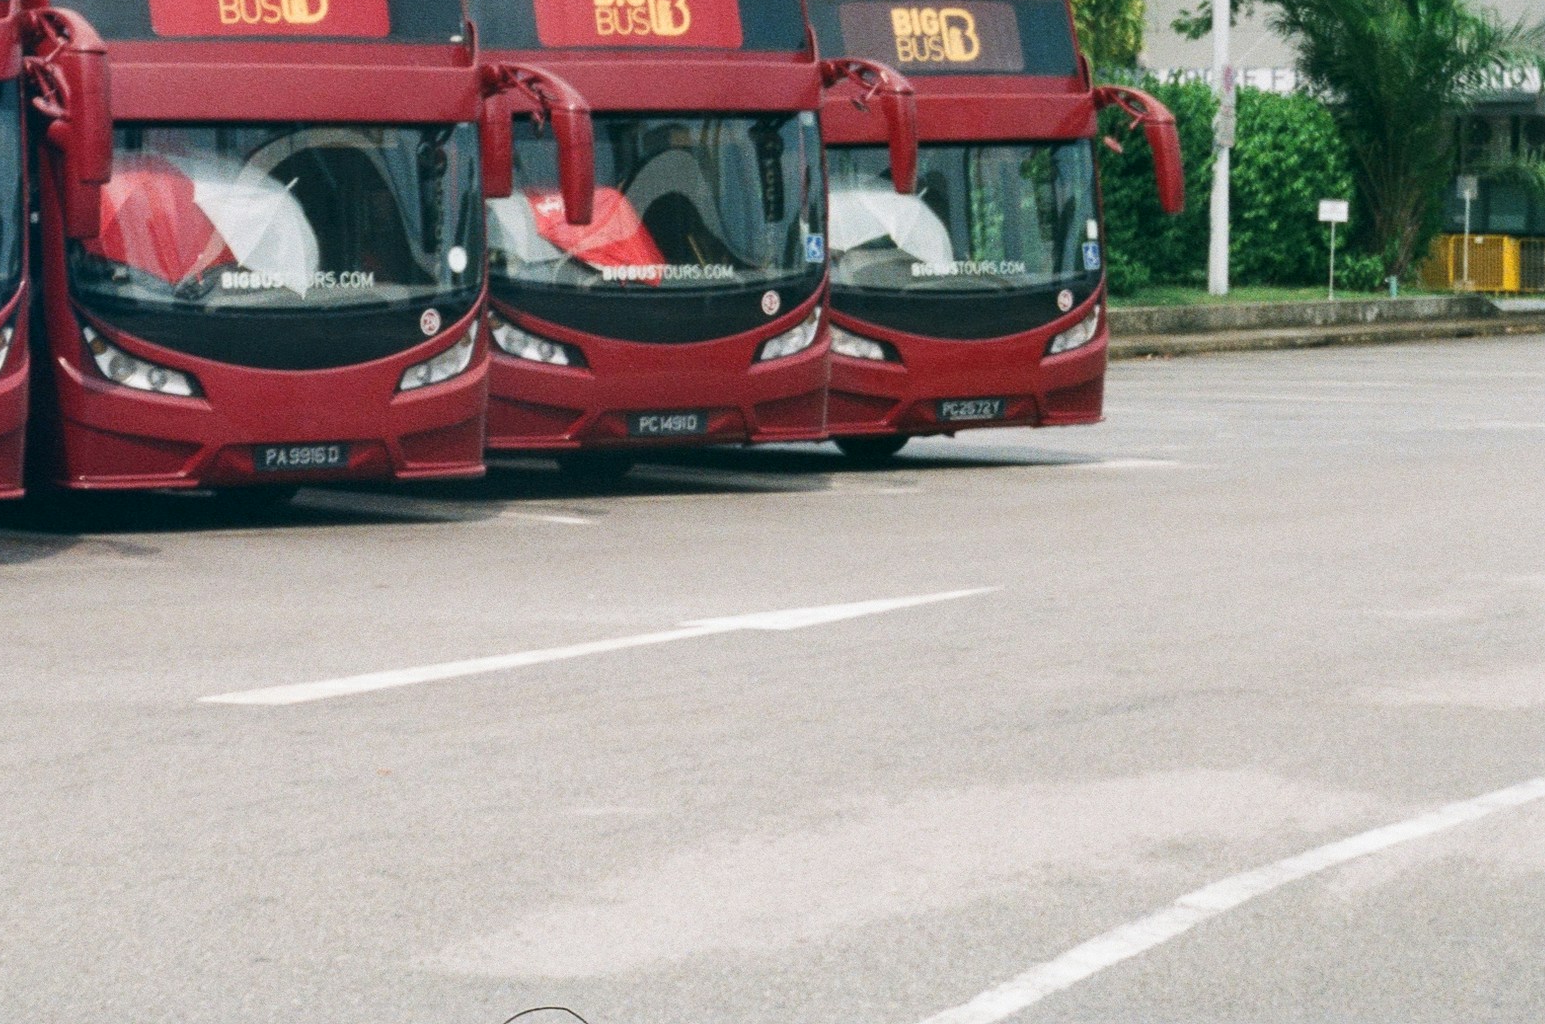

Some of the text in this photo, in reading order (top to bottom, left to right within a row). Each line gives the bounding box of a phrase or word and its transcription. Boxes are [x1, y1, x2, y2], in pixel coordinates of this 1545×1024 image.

[595, 8, 651, 35] BUS
[891, 7, 939, 36] BIG
[896, 36, 944, 62] BUS
[602, 263, 734, 281] BIGBUSTOURS.COM
[911, 260, 1026, 277] BIGSTOURS.COM
[221, 271, 374, 289] BIGBUSRS.COM
